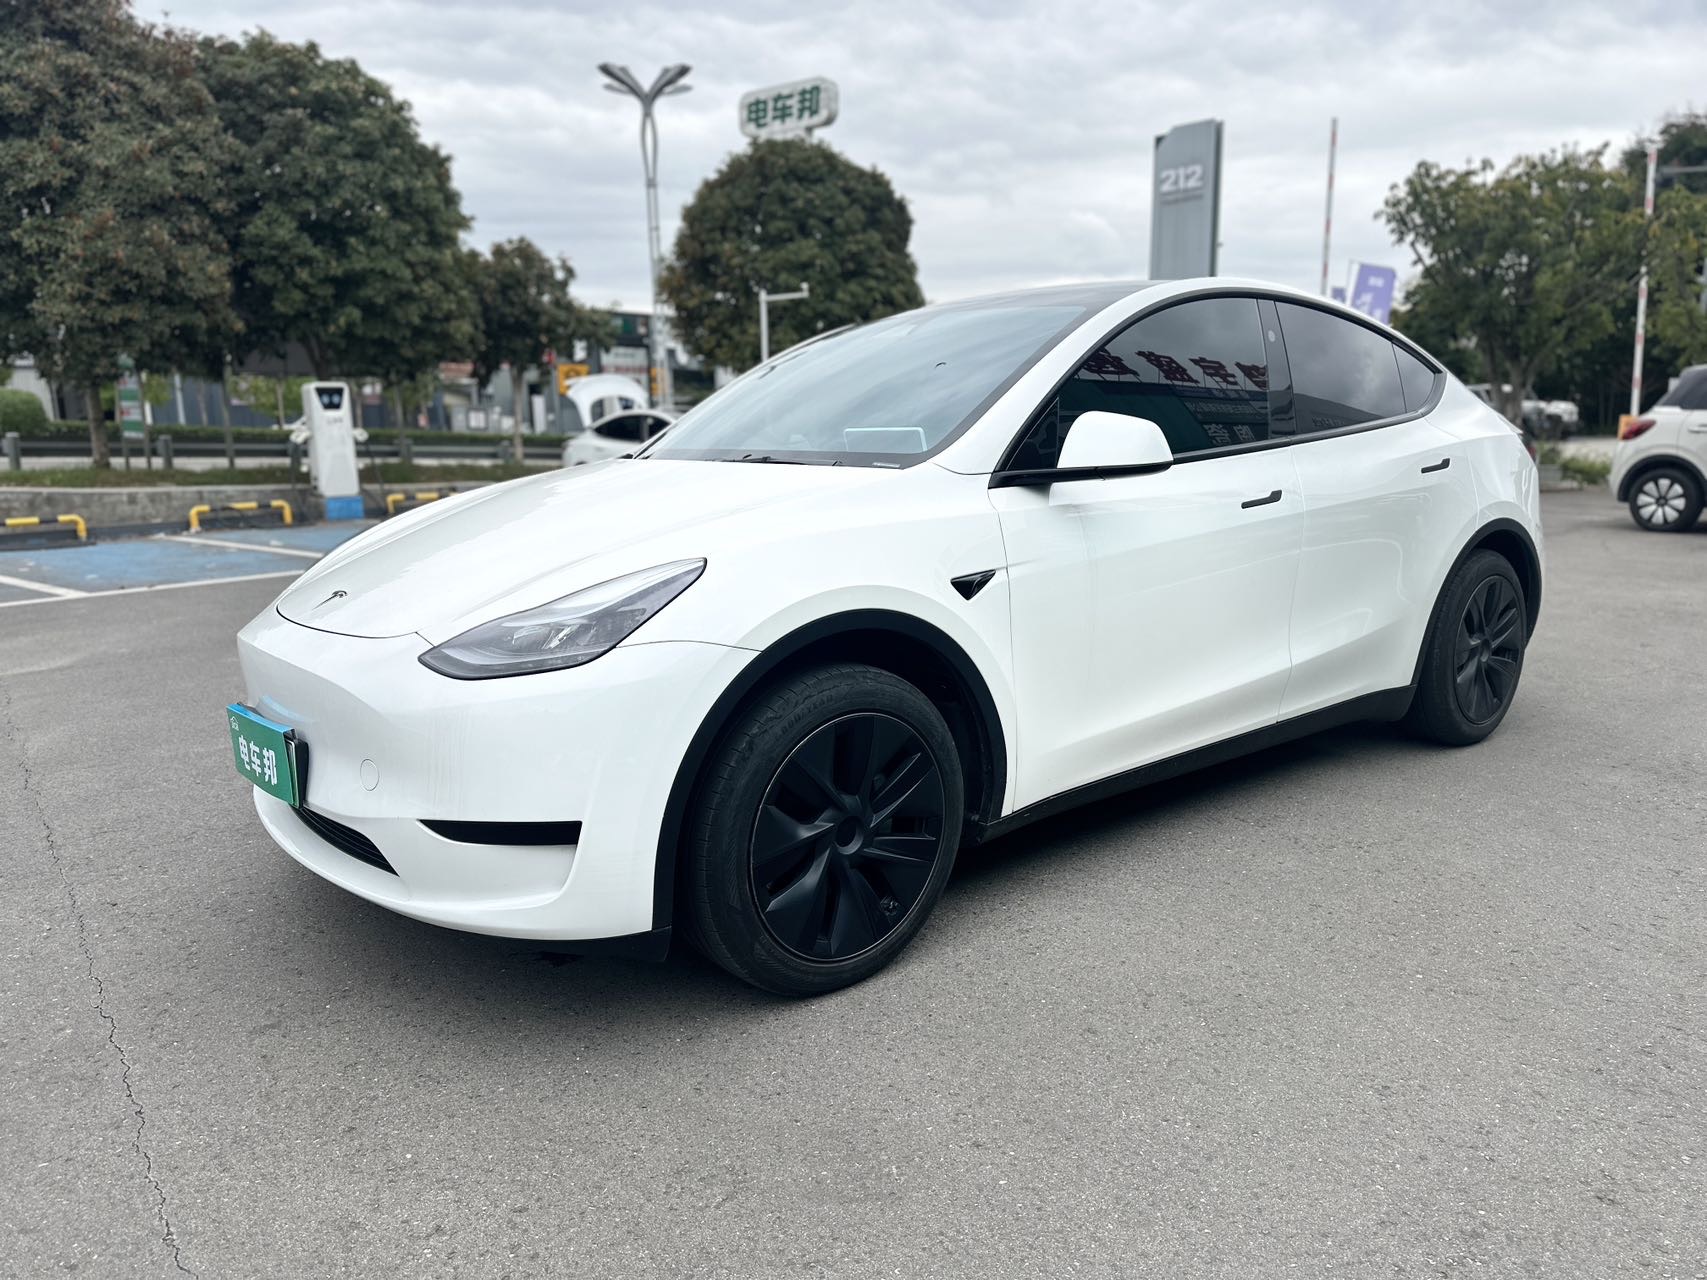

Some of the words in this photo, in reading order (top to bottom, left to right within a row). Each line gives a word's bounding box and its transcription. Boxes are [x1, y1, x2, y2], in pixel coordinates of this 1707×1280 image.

[747, 85, 821, 128] 电车邦
[1160, 164, 1203, 192] 212
[238, 734, 278, 786] 电车邦
